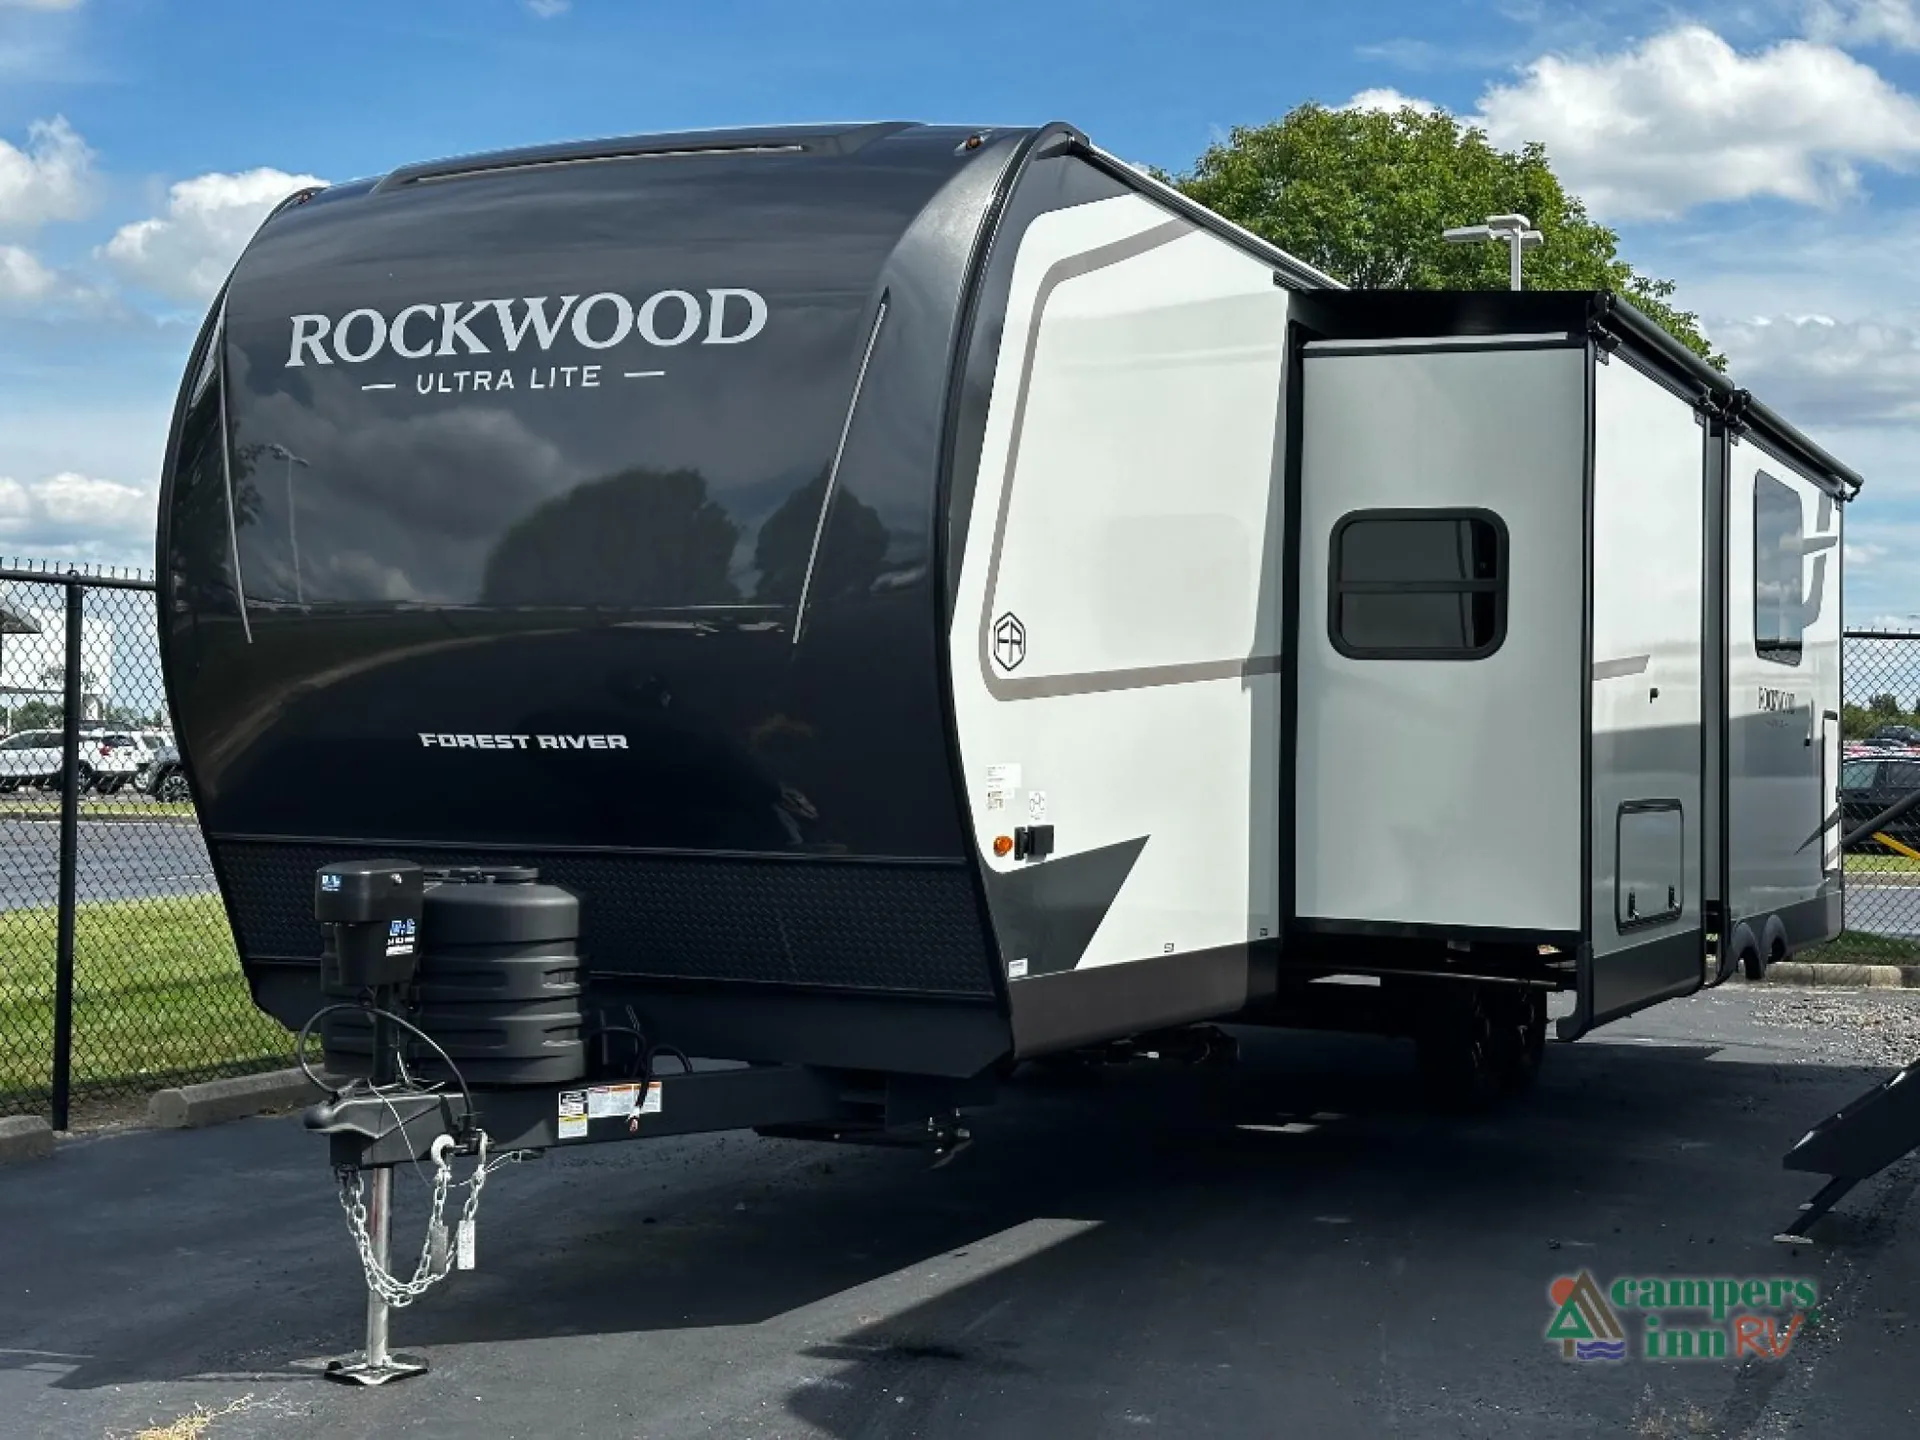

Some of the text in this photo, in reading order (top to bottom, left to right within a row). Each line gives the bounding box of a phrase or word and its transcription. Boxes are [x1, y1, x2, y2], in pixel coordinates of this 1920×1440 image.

[284, 288, 768, 368] ROCKWOOD
[416, 364, 602, 395] ULTRA LITE
[418, 732, 629, 749] FOREST RIVER
